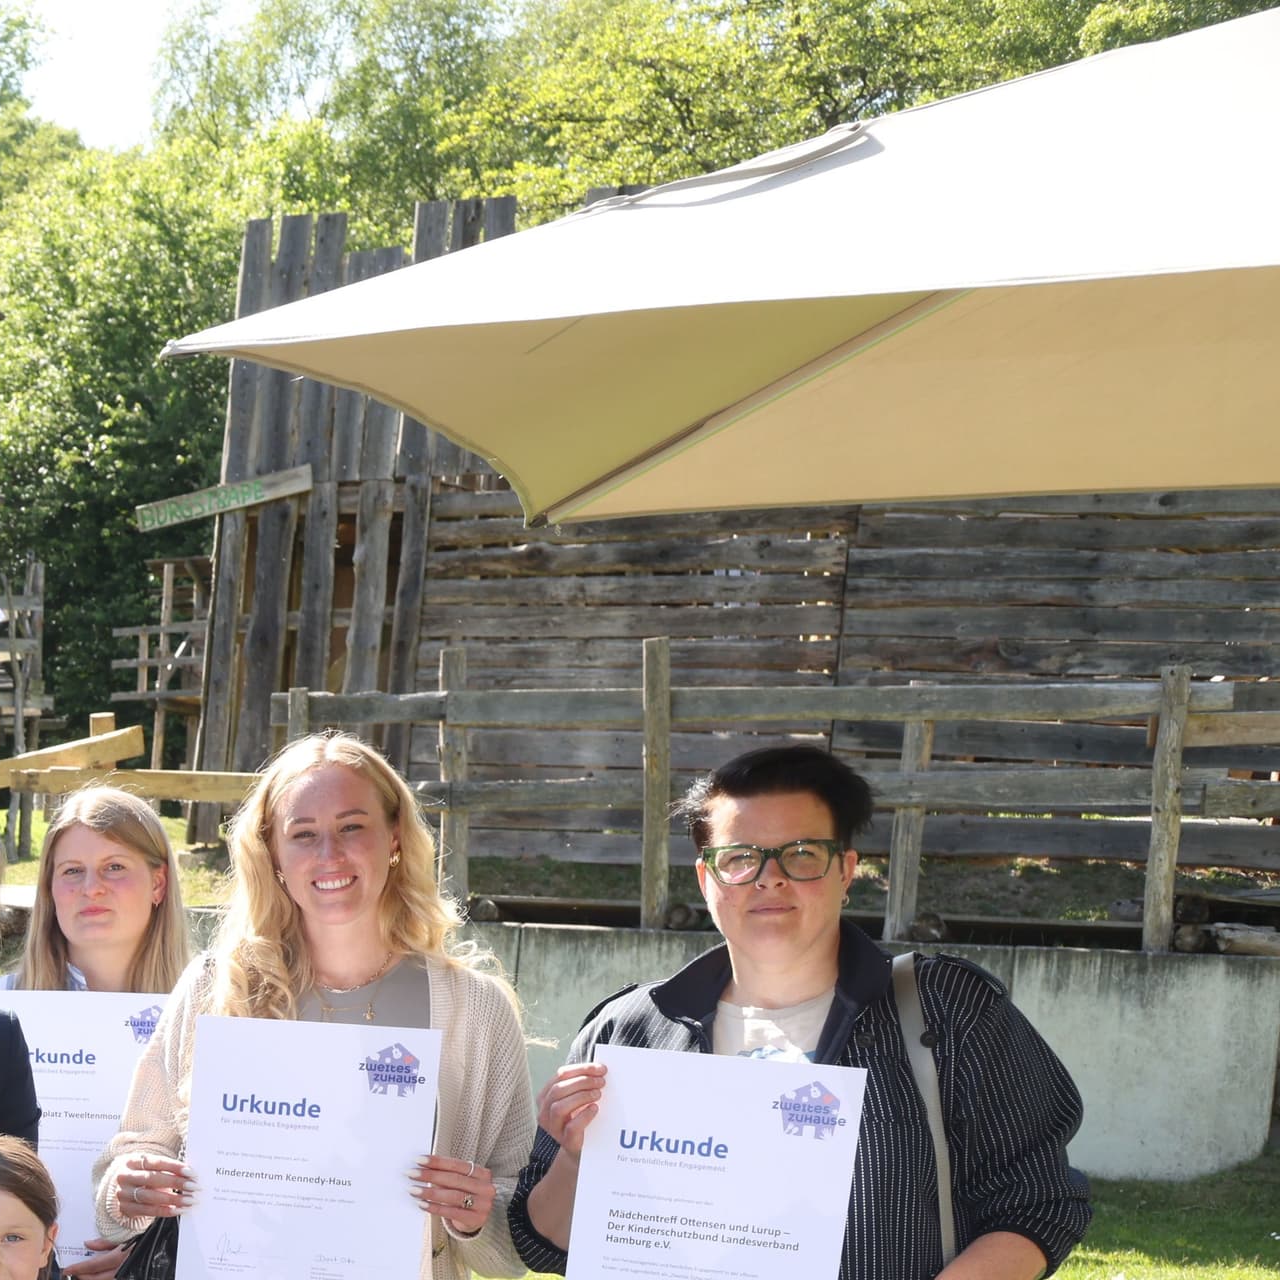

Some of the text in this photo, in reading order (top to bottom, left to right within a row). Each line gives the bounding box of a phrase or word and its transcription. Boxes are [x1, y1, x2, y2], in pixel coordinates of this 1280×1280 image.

[28, 1048, 96, 1065] kunde
[222, 1093, 321, 1118] Urkunde
[277, 1121, 320, 1131] Engagement
[619, 1129, 729, 1158] Urkunde
[617, 1155, 726, 1173] für vorbildliches Engagement
[215, 1167, 352, 1187] Kinderzentrum Kennedy-Haus
[609, 1208, 677, 1226] Mädchentreff
[680, 1216, 726, 1230] Ottensen
[729, 1223, 748, 1233] und
[752, 1225, 781, 1238] Lurup
[605, 1234, 671, 1250] Hamburg e.V.
[607, 1221, 800, 1252] Der Kinderschutzbund Landesverband
